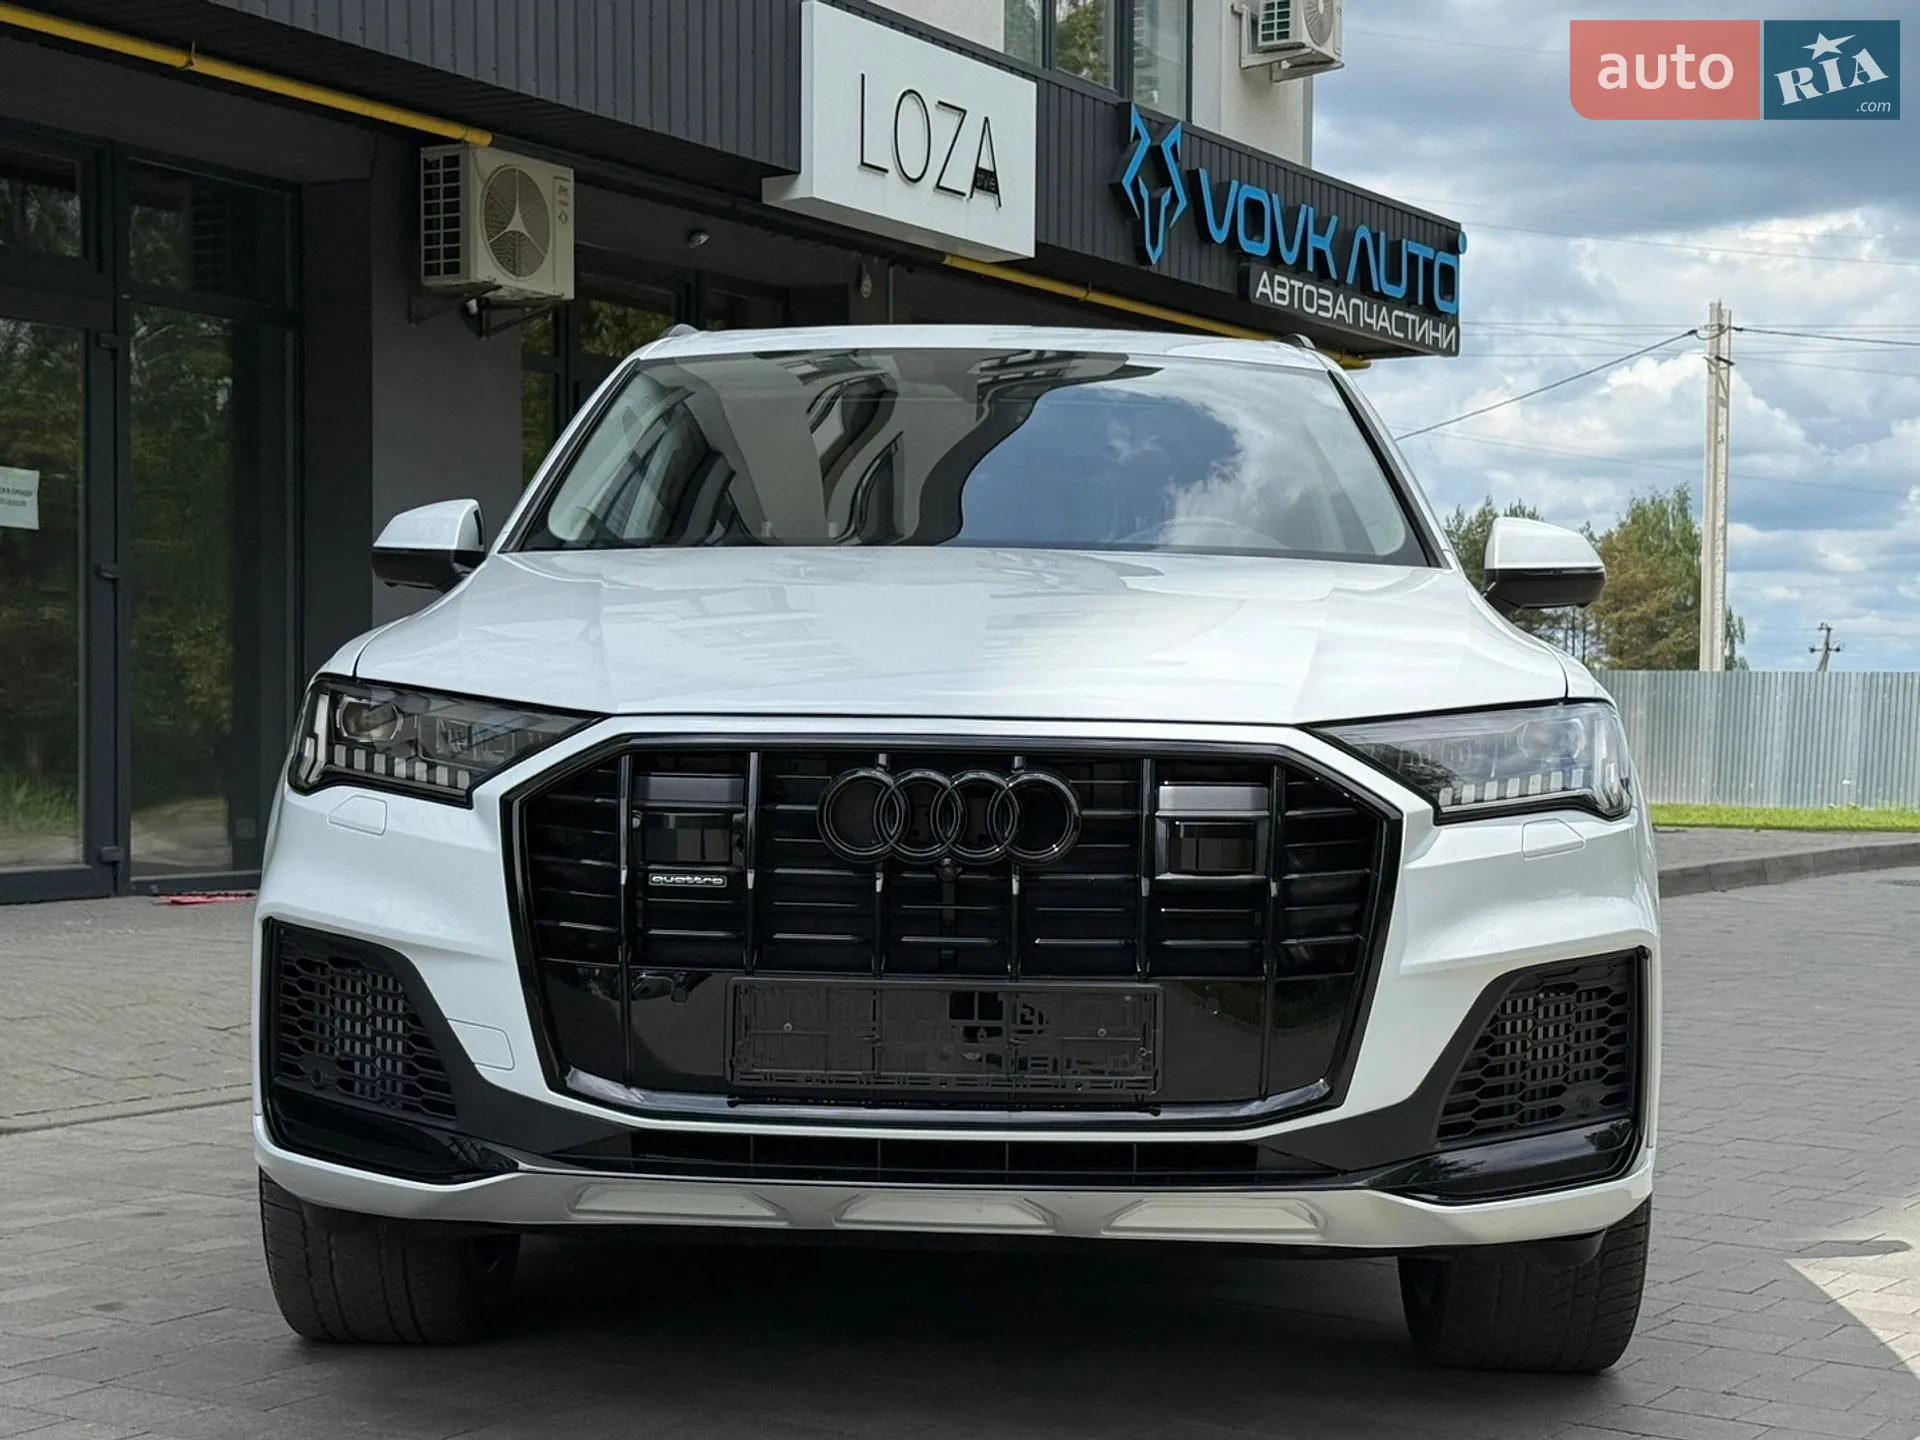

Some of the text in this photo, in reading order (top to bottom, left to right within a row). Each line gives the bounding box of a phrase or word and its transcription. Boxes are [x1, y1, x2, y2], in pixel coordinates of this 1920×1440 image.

[859, 72, 1001, 208] LOZA
[1199, 168, 1460, 314] VOVK AUTO
[1256, 272, 1456, 352] АВТОЗАПЧАСТИНИ
[652, 876, 723, 884] quattro
